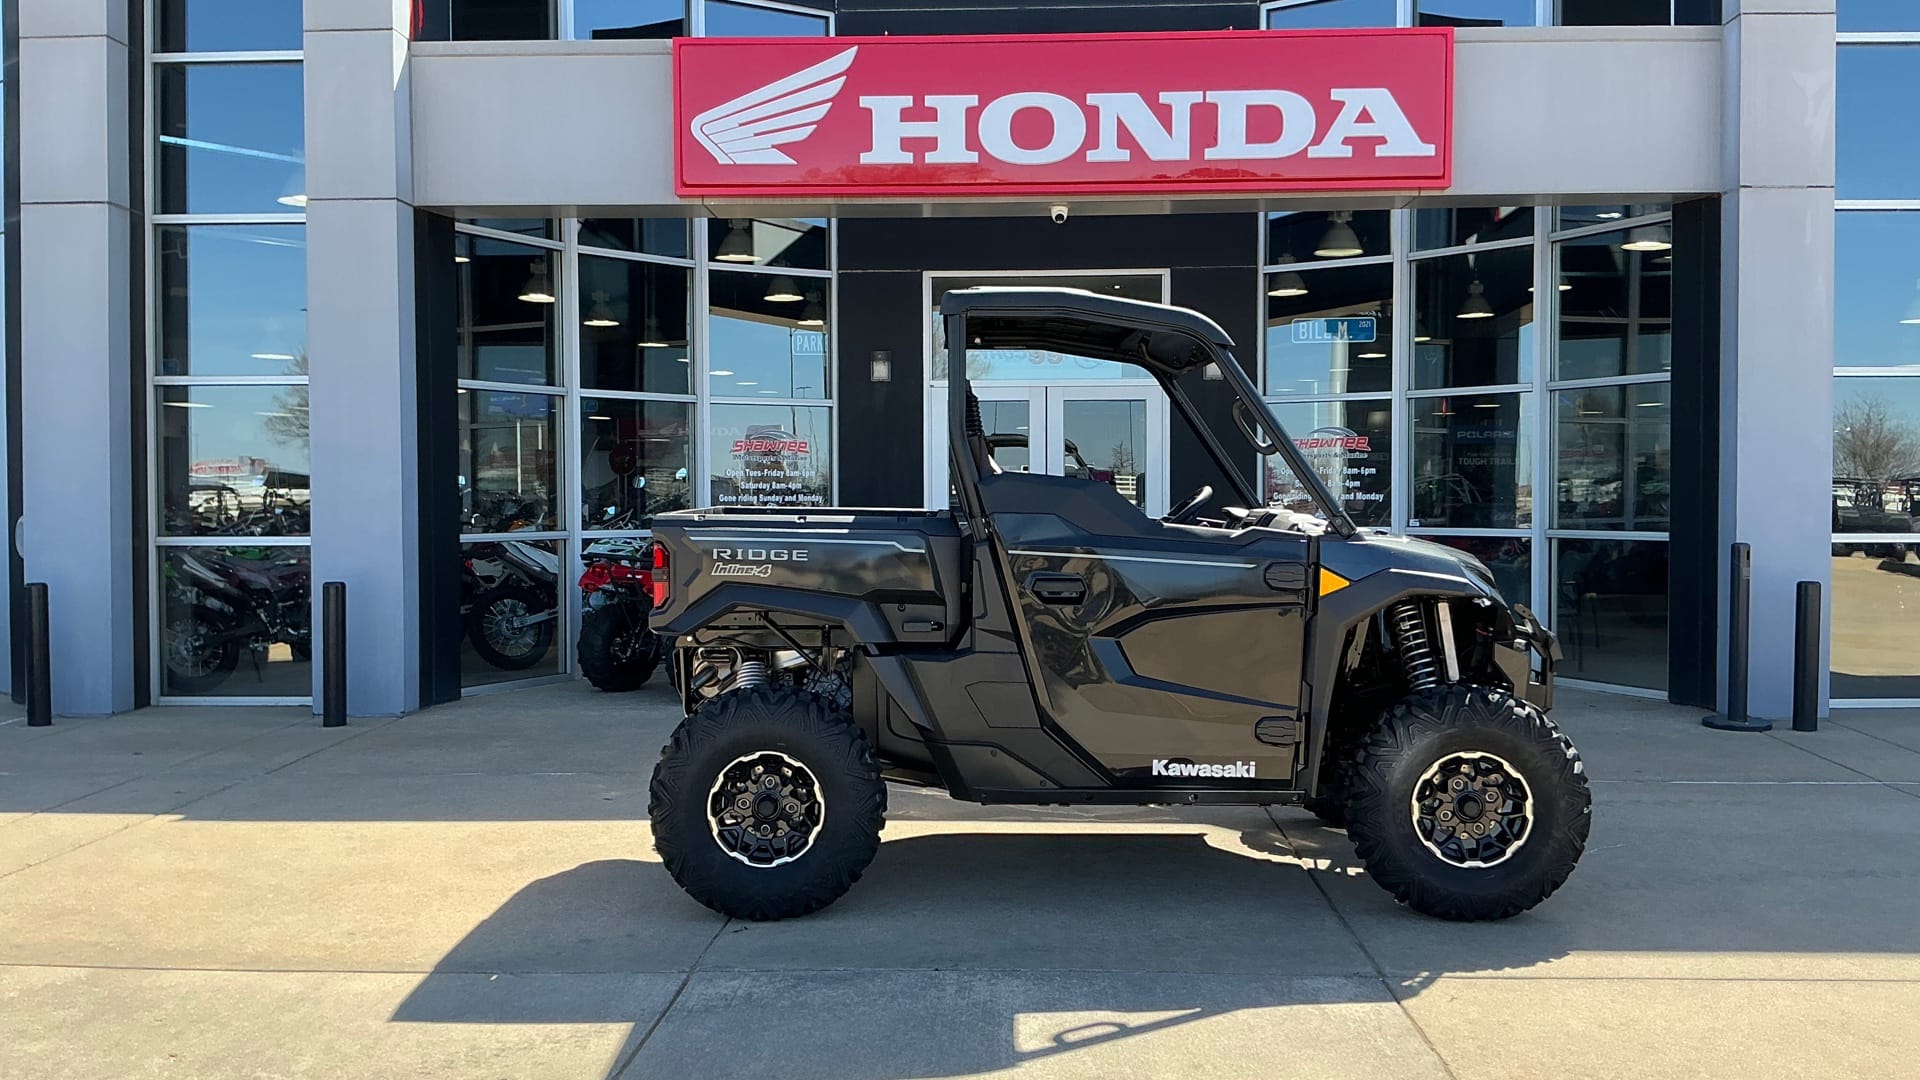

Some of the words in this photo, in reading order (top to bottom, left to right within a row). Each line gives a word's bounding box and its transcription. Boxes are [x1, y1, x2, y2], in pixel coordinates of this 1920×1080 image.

[858, 87, 1437, 166] HONDA
[1299, 321, 1333, 340] BILL
[797, 335, 823, 352] PARK
[726, 469, 743, 478] Open
[745, 468, 784, 478] Tues-Friday
[1342, 467, 1376, 476] 8am-6pm
[740, 481, 770, 491] Saturday
[771, 481, 802, 491] 8am-4pm
[718, 494, 737, 503] Gone
[738, 494, 758, 504] riding
[759, 494, 783, 504] Sunday
[784, 494, 797, 502] and
[797, 494, 823, 504] Monday
[1356, 492, 1384, 502] Monday
[712, 548, 809, 561] RIDGE
[1152, 759, 1257, 778] Kawasaki
